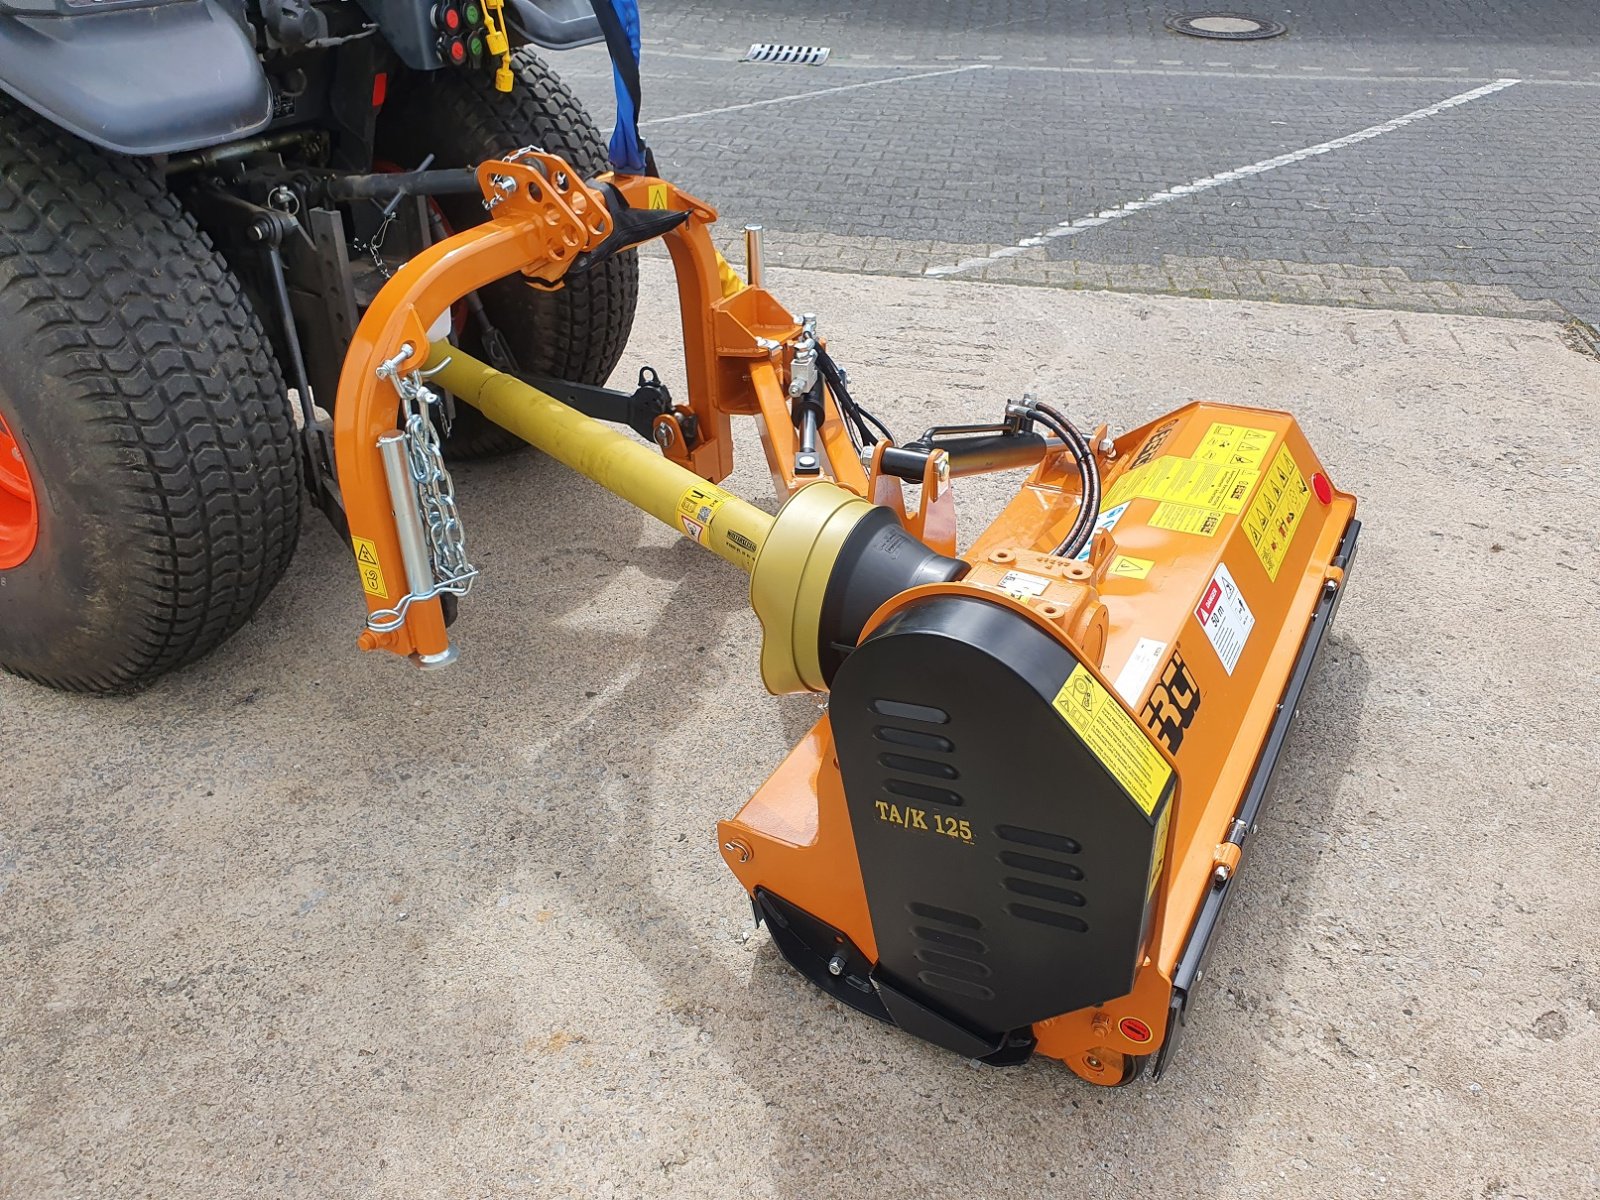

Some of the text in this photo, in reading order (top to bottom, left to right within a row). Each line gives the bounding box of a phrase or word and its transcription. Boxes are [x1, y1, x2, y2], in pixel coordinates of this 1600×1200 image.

[1205, 587, 1218, 609] DANGER
[1211, 612, 1220, 628] 50
[875, 799, 973, 841] TA/K 125
